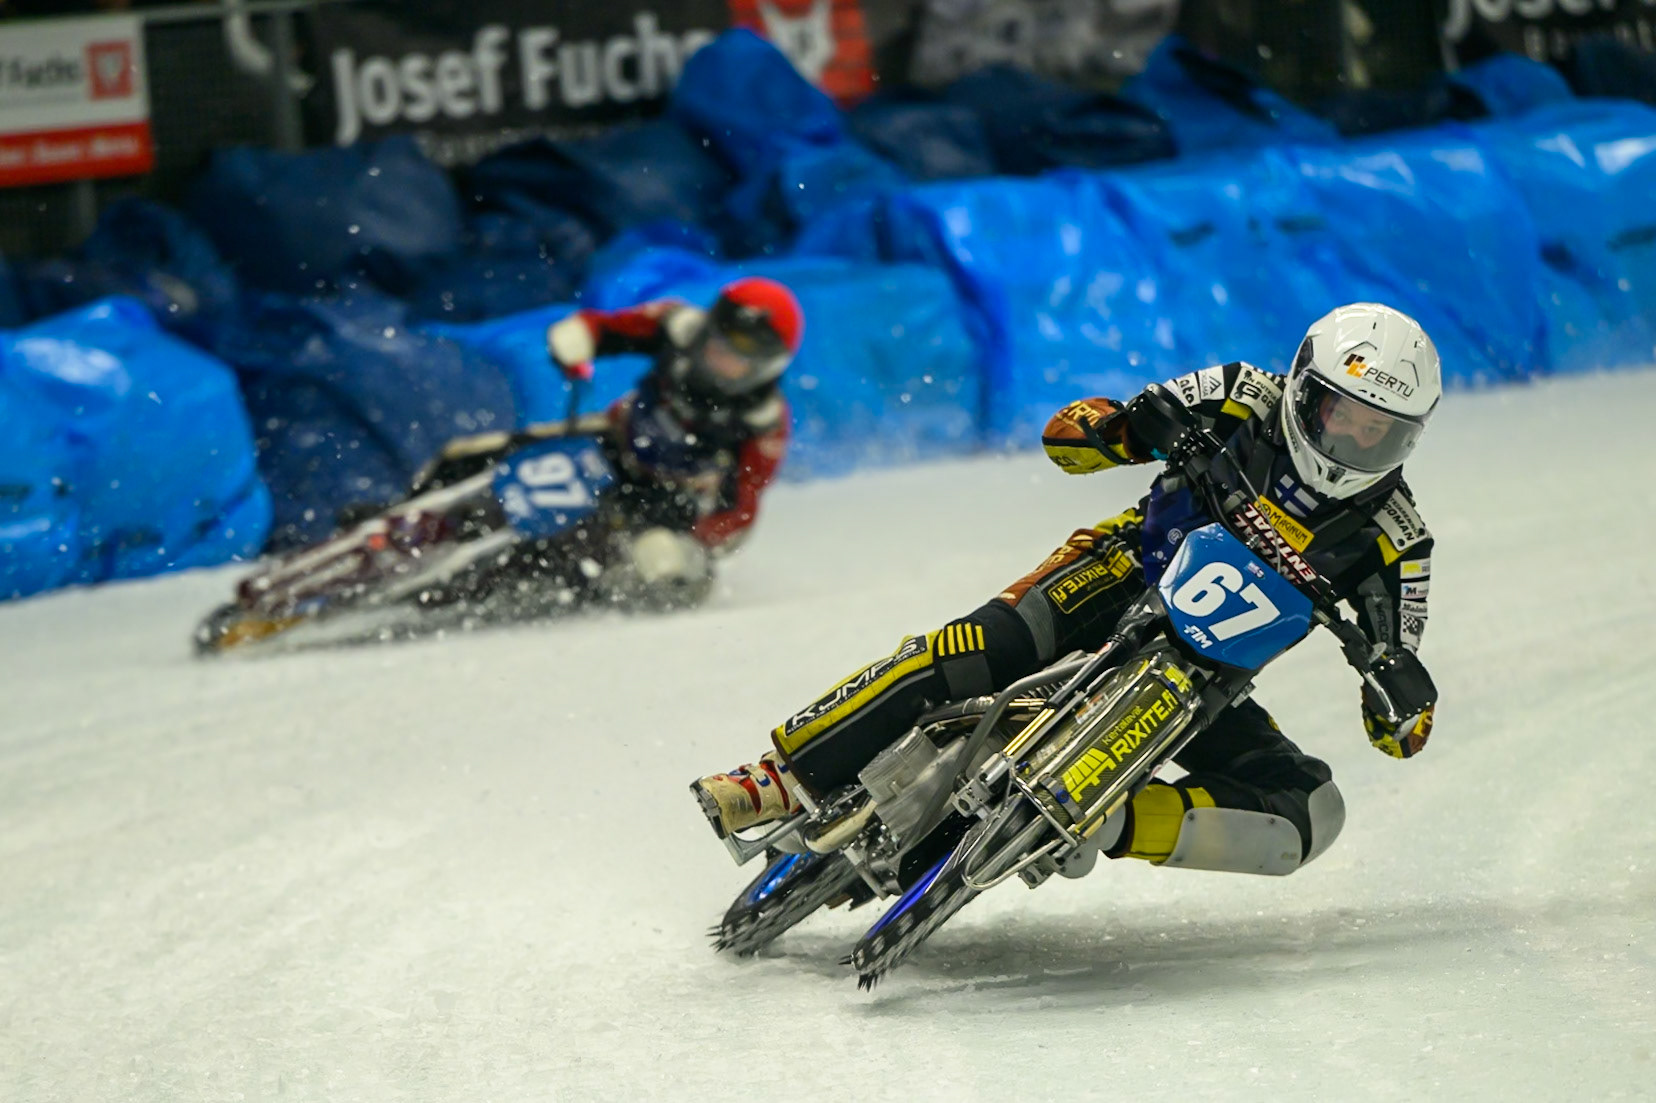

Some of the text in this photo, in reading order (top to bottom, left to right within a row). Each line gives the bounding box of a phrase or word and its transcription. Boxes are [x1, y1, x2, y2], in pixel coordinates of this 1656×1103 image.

[330, 24, 511, 147] Josef
[1364, 367, 1414, 398] PERTU
[517, 452, 587, 508] 97
[1270, 510, 1308, 544] MAGNUM
[1052, 562, 1109, 604] RIXITE.fi
[1172, 561, 1281, 642] 67
[1187, 624, 1213, 649] FIM
[1110, 688, 1179, 763] RIXITE.fi
